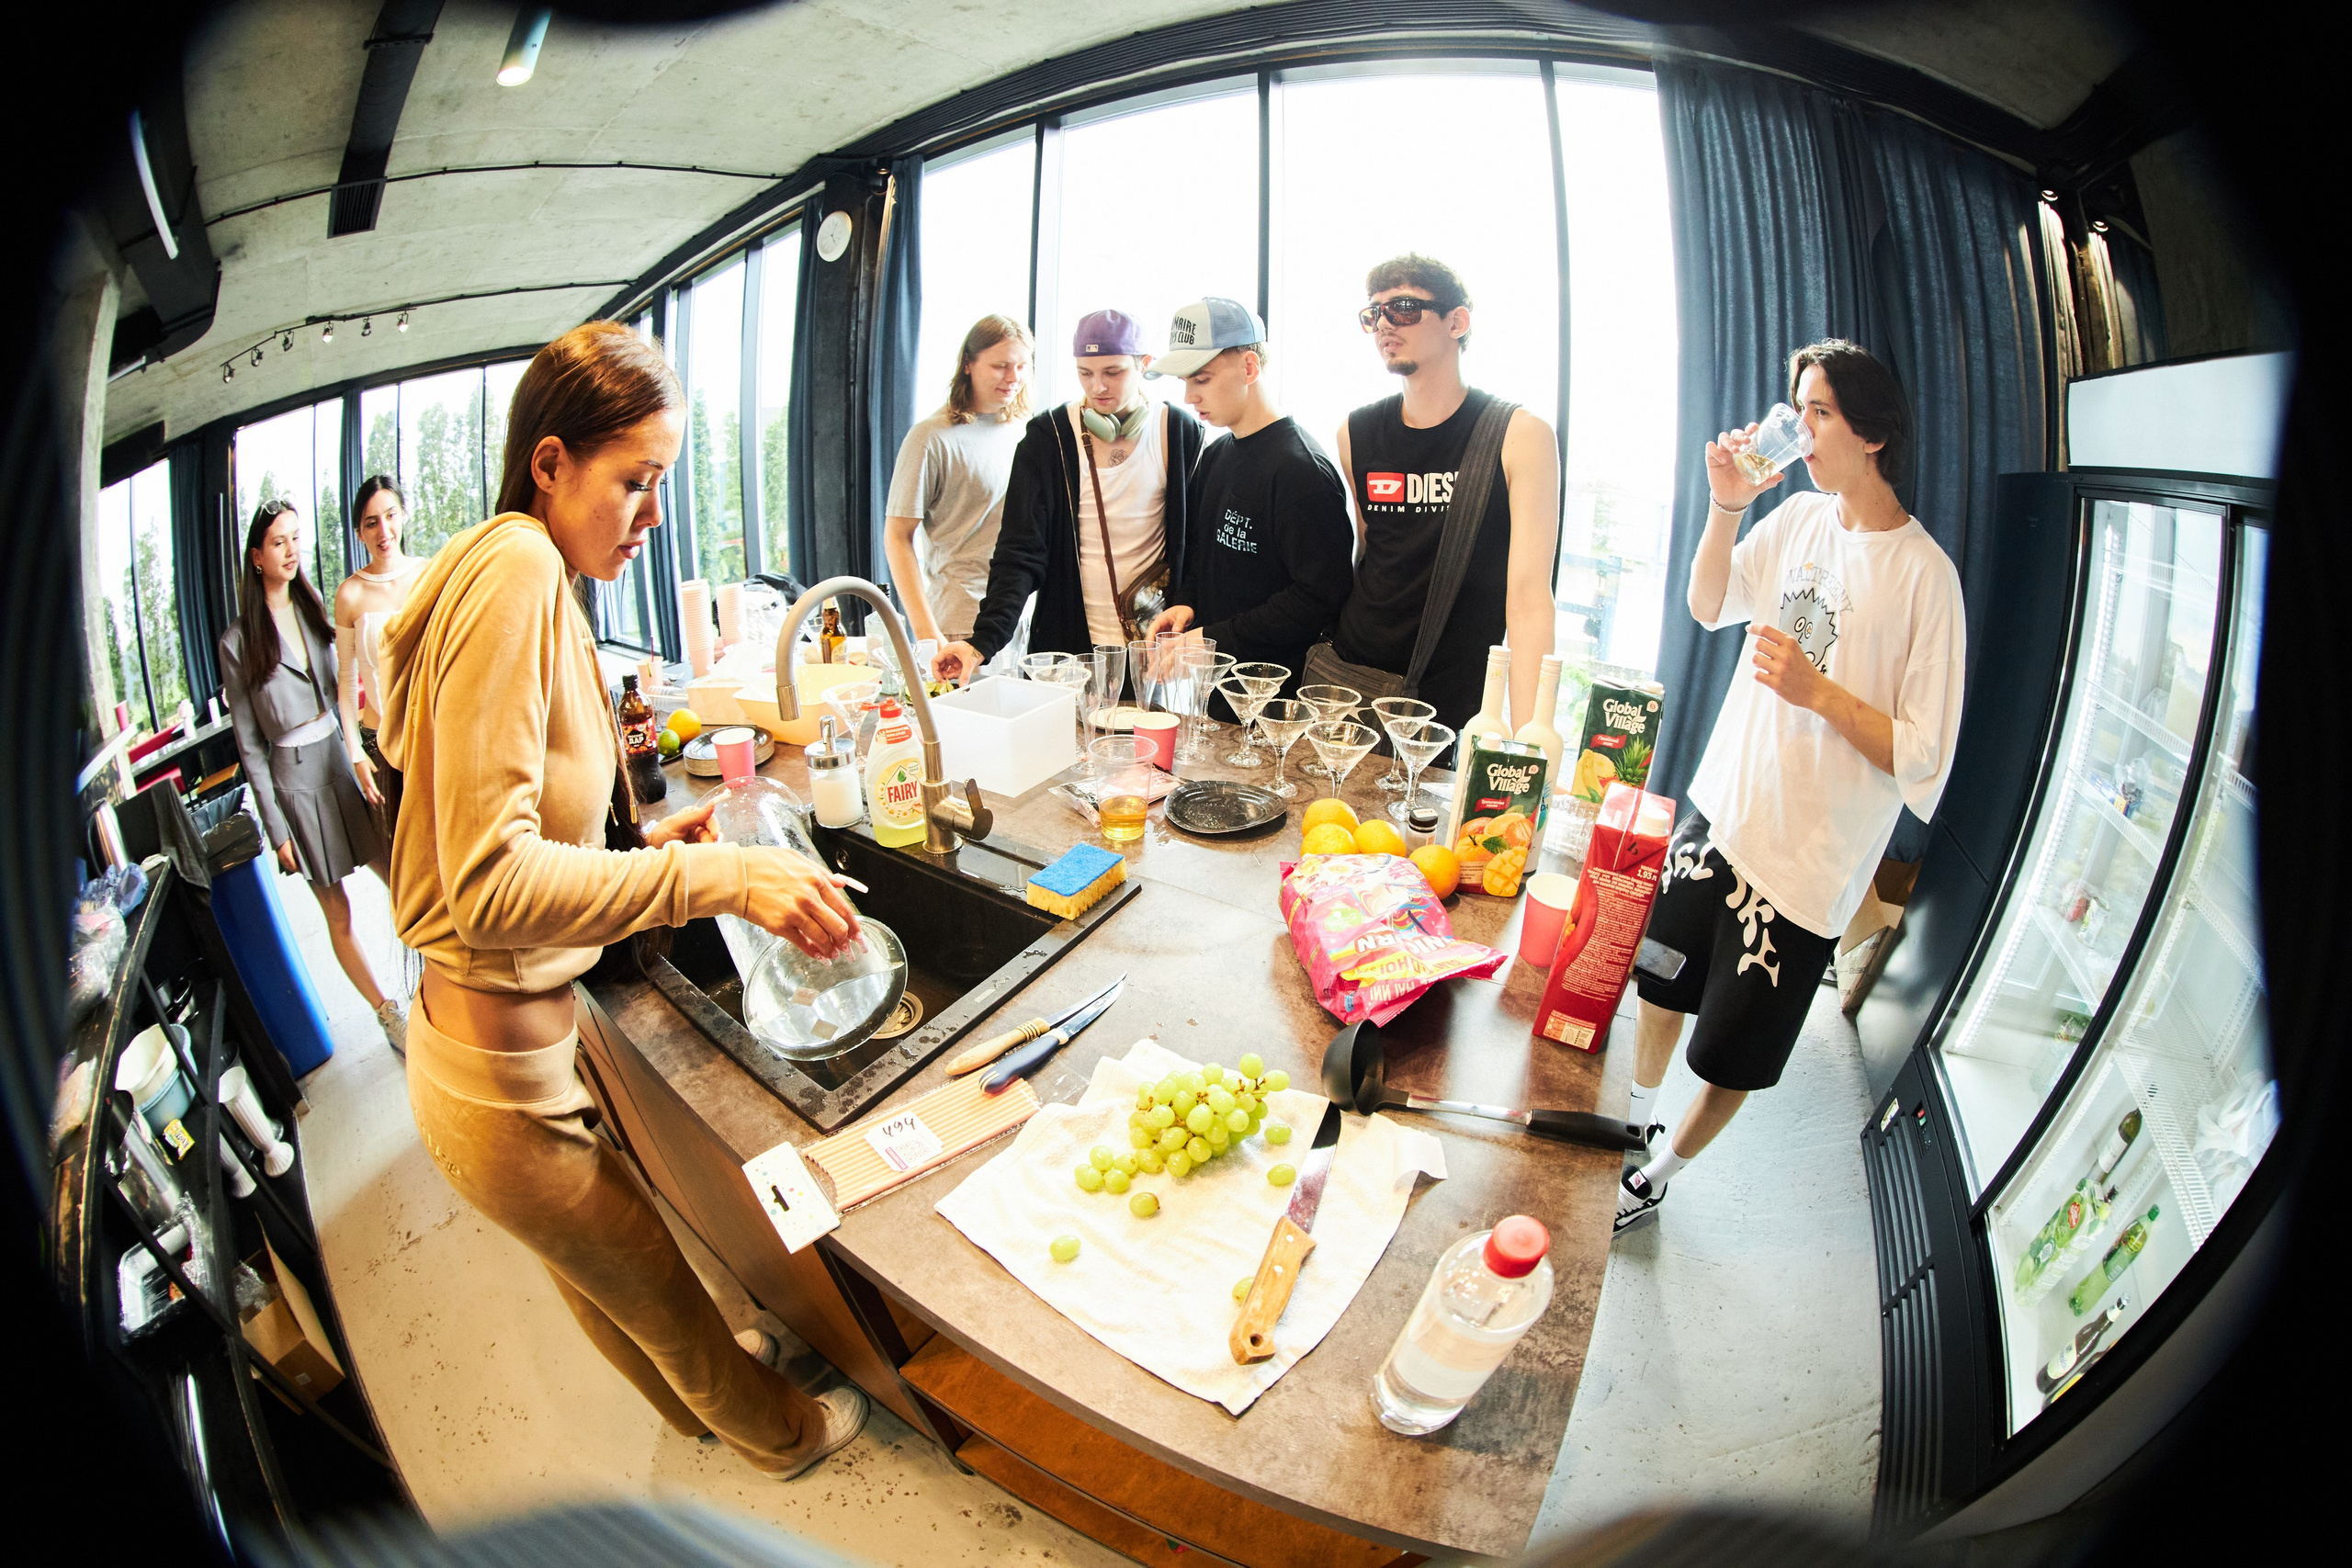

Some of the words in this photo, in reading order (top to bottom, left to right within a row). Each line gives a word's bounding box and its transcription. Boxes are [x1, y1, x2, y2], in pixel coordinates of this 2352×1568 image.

[1178, 332, 1194, 344] CLUB
[1407, 471, 1458, 503] DIES
[1367, 504, 1405, 513] DENIM
[1224, 523, 1234, 535] de
[1237, 527, 1247, 539] la
[1216, 529, 1257, 553] GALERIE
[1602, 698, 1643, 716] Global
[1605, 712, 1645, 734] Village
[1487, 763, 1528, 778] Global
[888, 781, 918, 803] FAIRY
[1488, 776, 1530, 795] Village
[1637, 869, 1653, 880] 1,93
